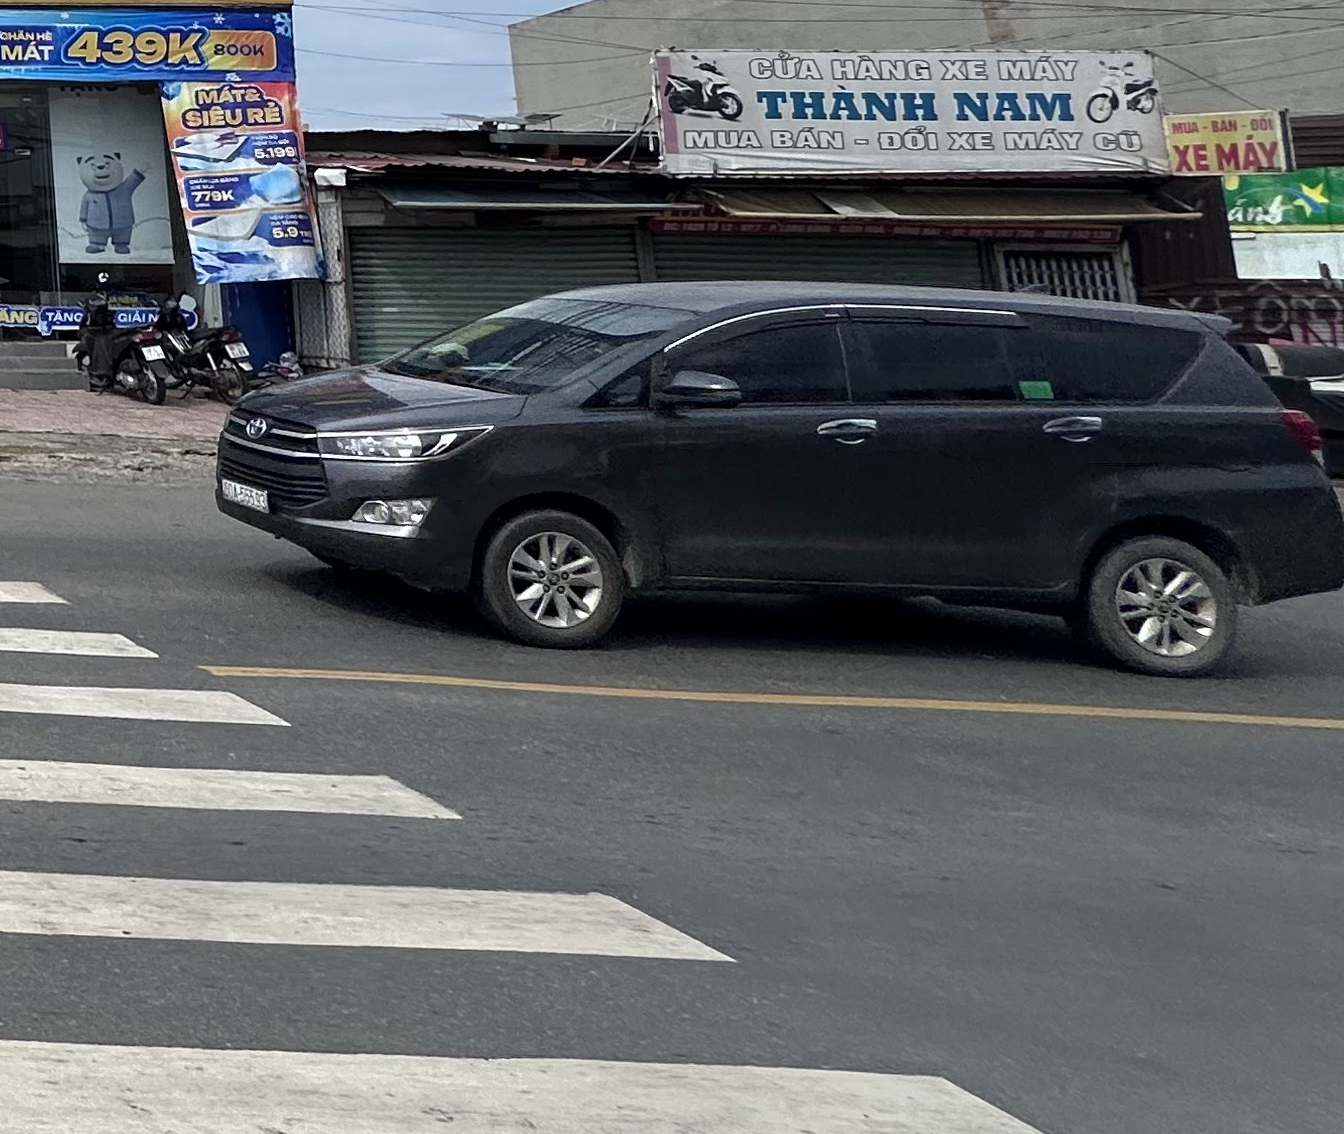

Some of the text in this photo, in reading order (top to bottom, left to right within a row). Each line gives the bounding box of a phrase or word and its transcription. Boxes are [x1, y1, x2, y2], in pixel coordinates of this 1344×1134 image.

[36, 30, 52, 41] HÈ
[67, 30, 203, 65] 439K
[0, 41, 54, 61] MÁT
[213, 43, 265, 57] 800K
[749, 52, 1079, 81] CỬA HÀNG XE MÁY
[185, 101, 281, 127] SIÊU RẺ
[756, 84, 1075, 121] THÀNH NAM
[684, 129, 763, 150] MUA
[771, 126, 845, 150] BÁN
[877, 125, 939, 151] ĐỔI
[947, 130, 995, 151] XE
[1004, 126, 1083, 151] MÁY
[1093, 129, 1143, 152] CŨ
[1171, 121, 1200, 135] MUA
[1172, 134, 1279, 172] XE MÁY
[191, 190, 235, 202] 779K
